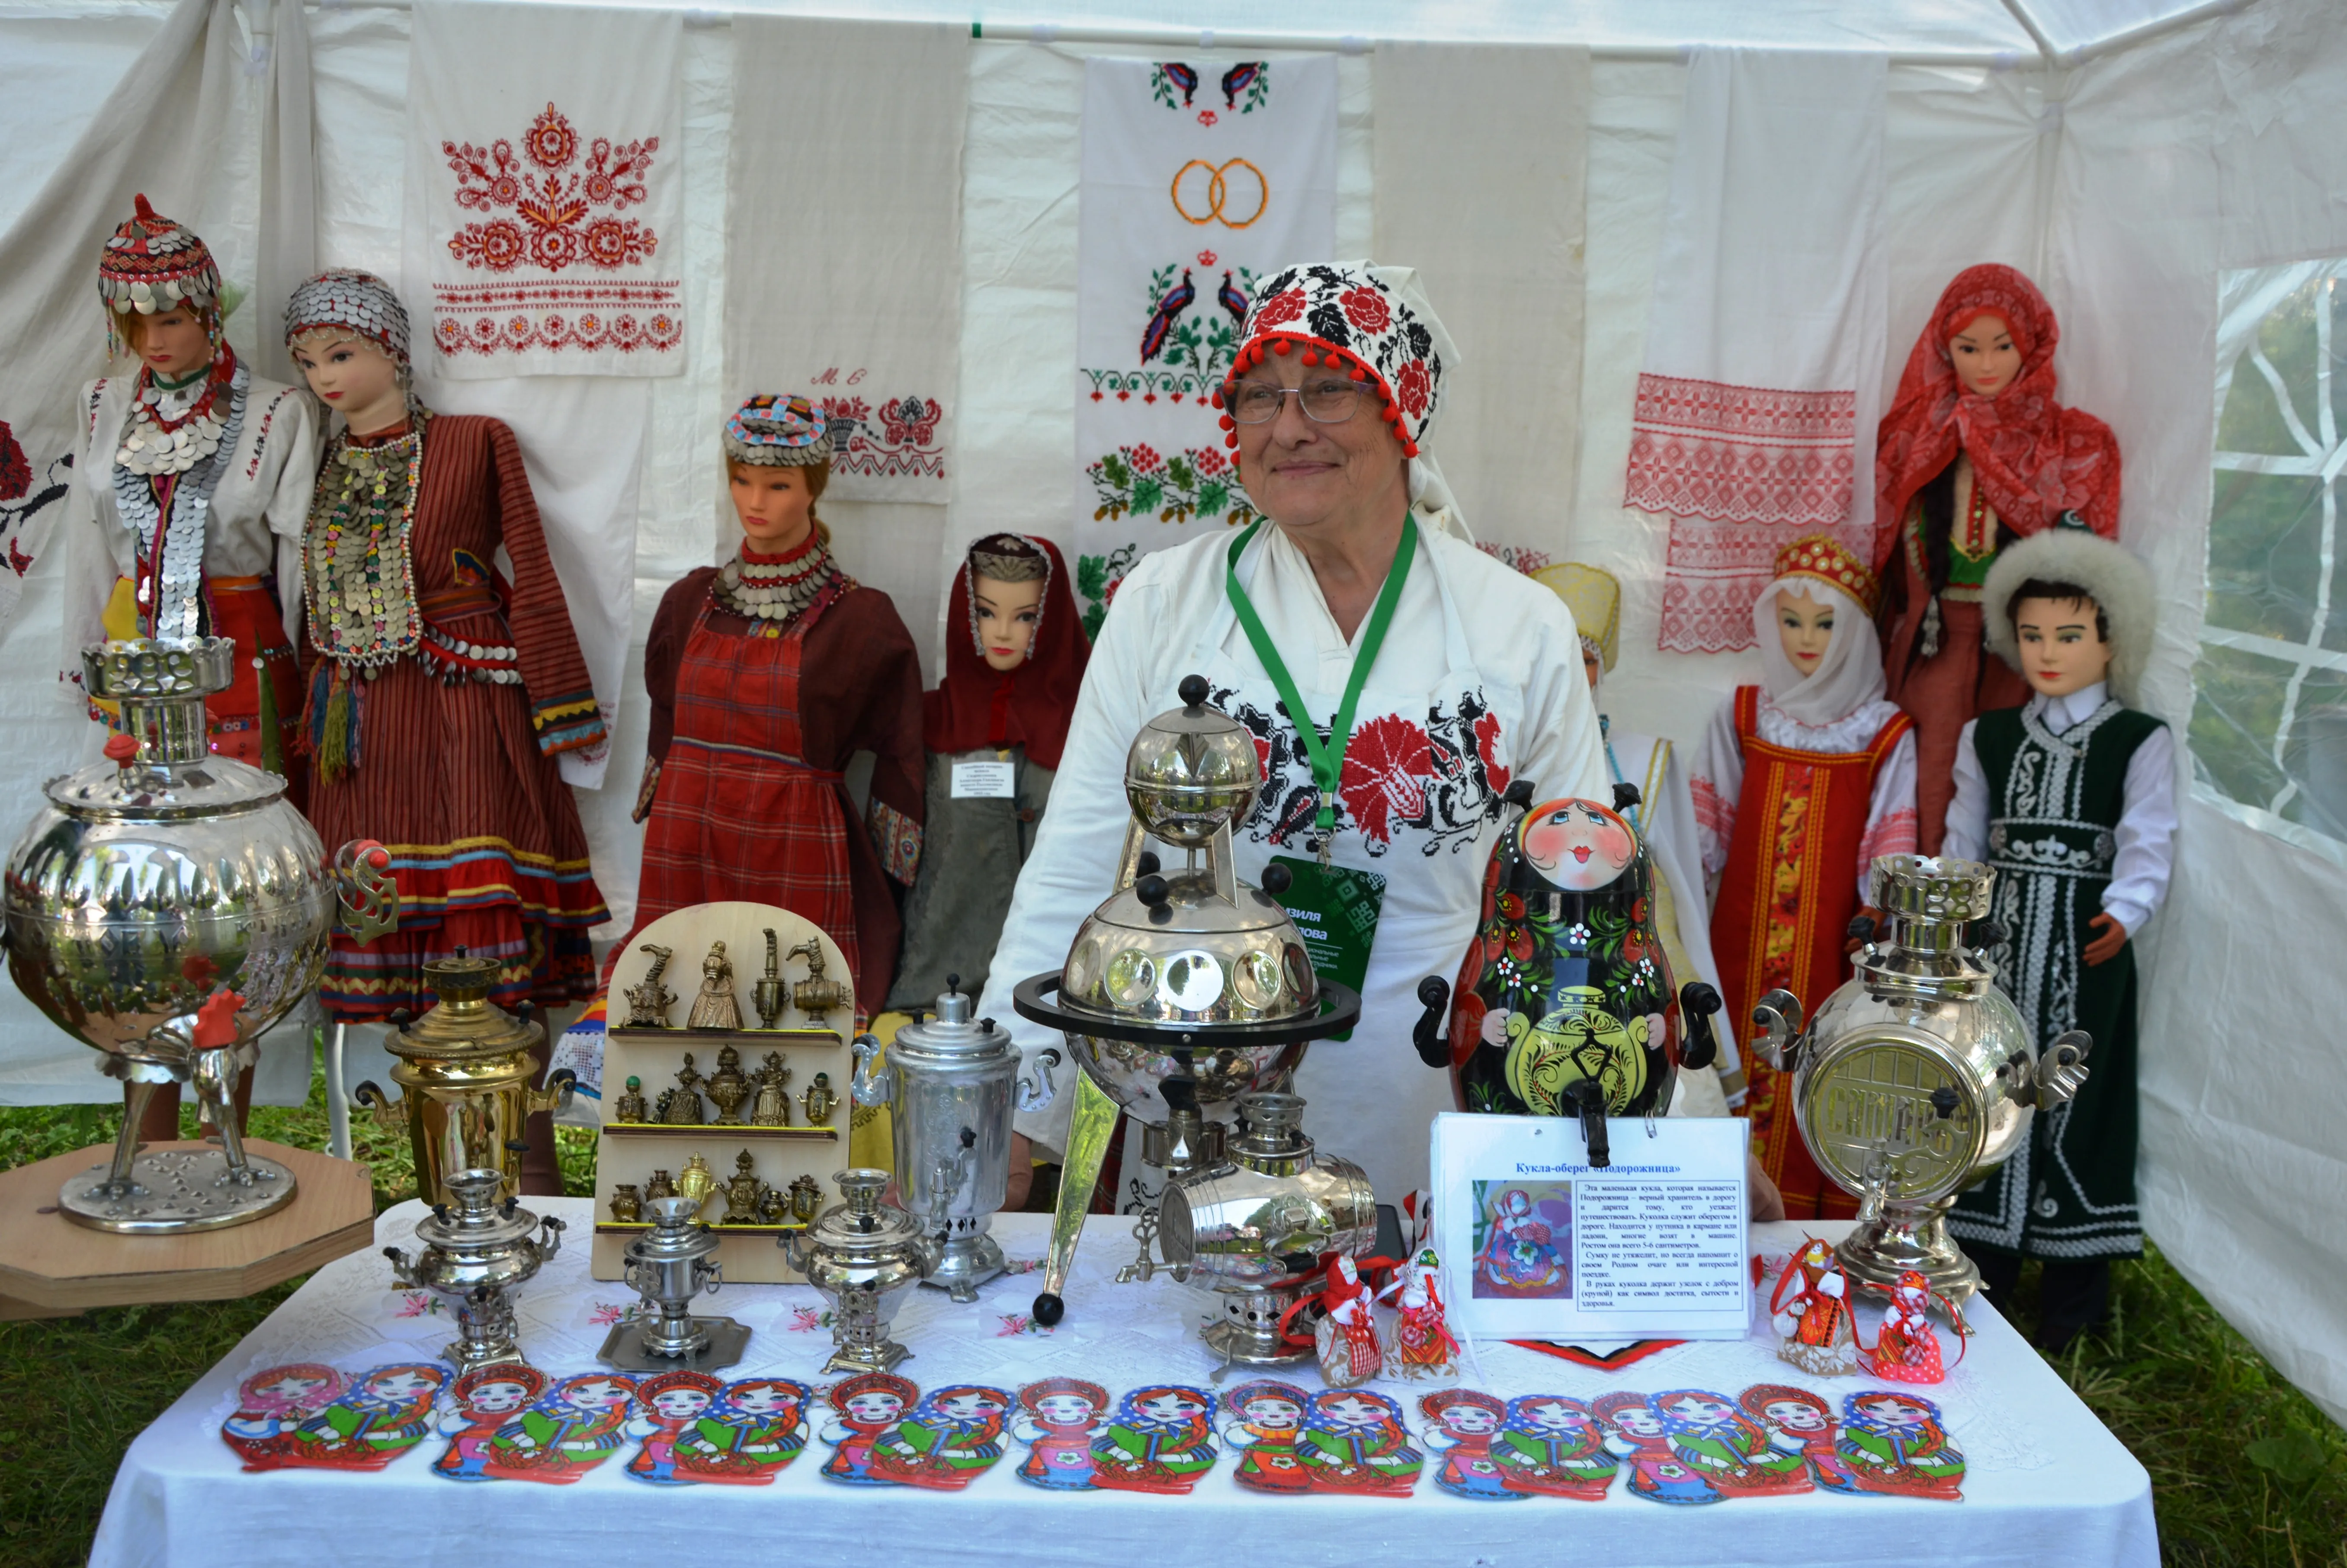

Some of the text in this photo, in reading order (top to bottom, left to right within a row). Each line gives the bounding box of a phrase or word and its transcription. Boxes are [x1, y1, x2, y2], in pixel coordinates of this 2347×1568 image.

[1516, 1163, 1589, 1175] Кукла-оберег
[1581, 1193, 1629, 1202] Подорожница
[1639, 1193, 1664, 1202] верный
[1640, 1213, 1669, 1221] Куколка
[1699, 1213, 1730, 1221] оберегом
